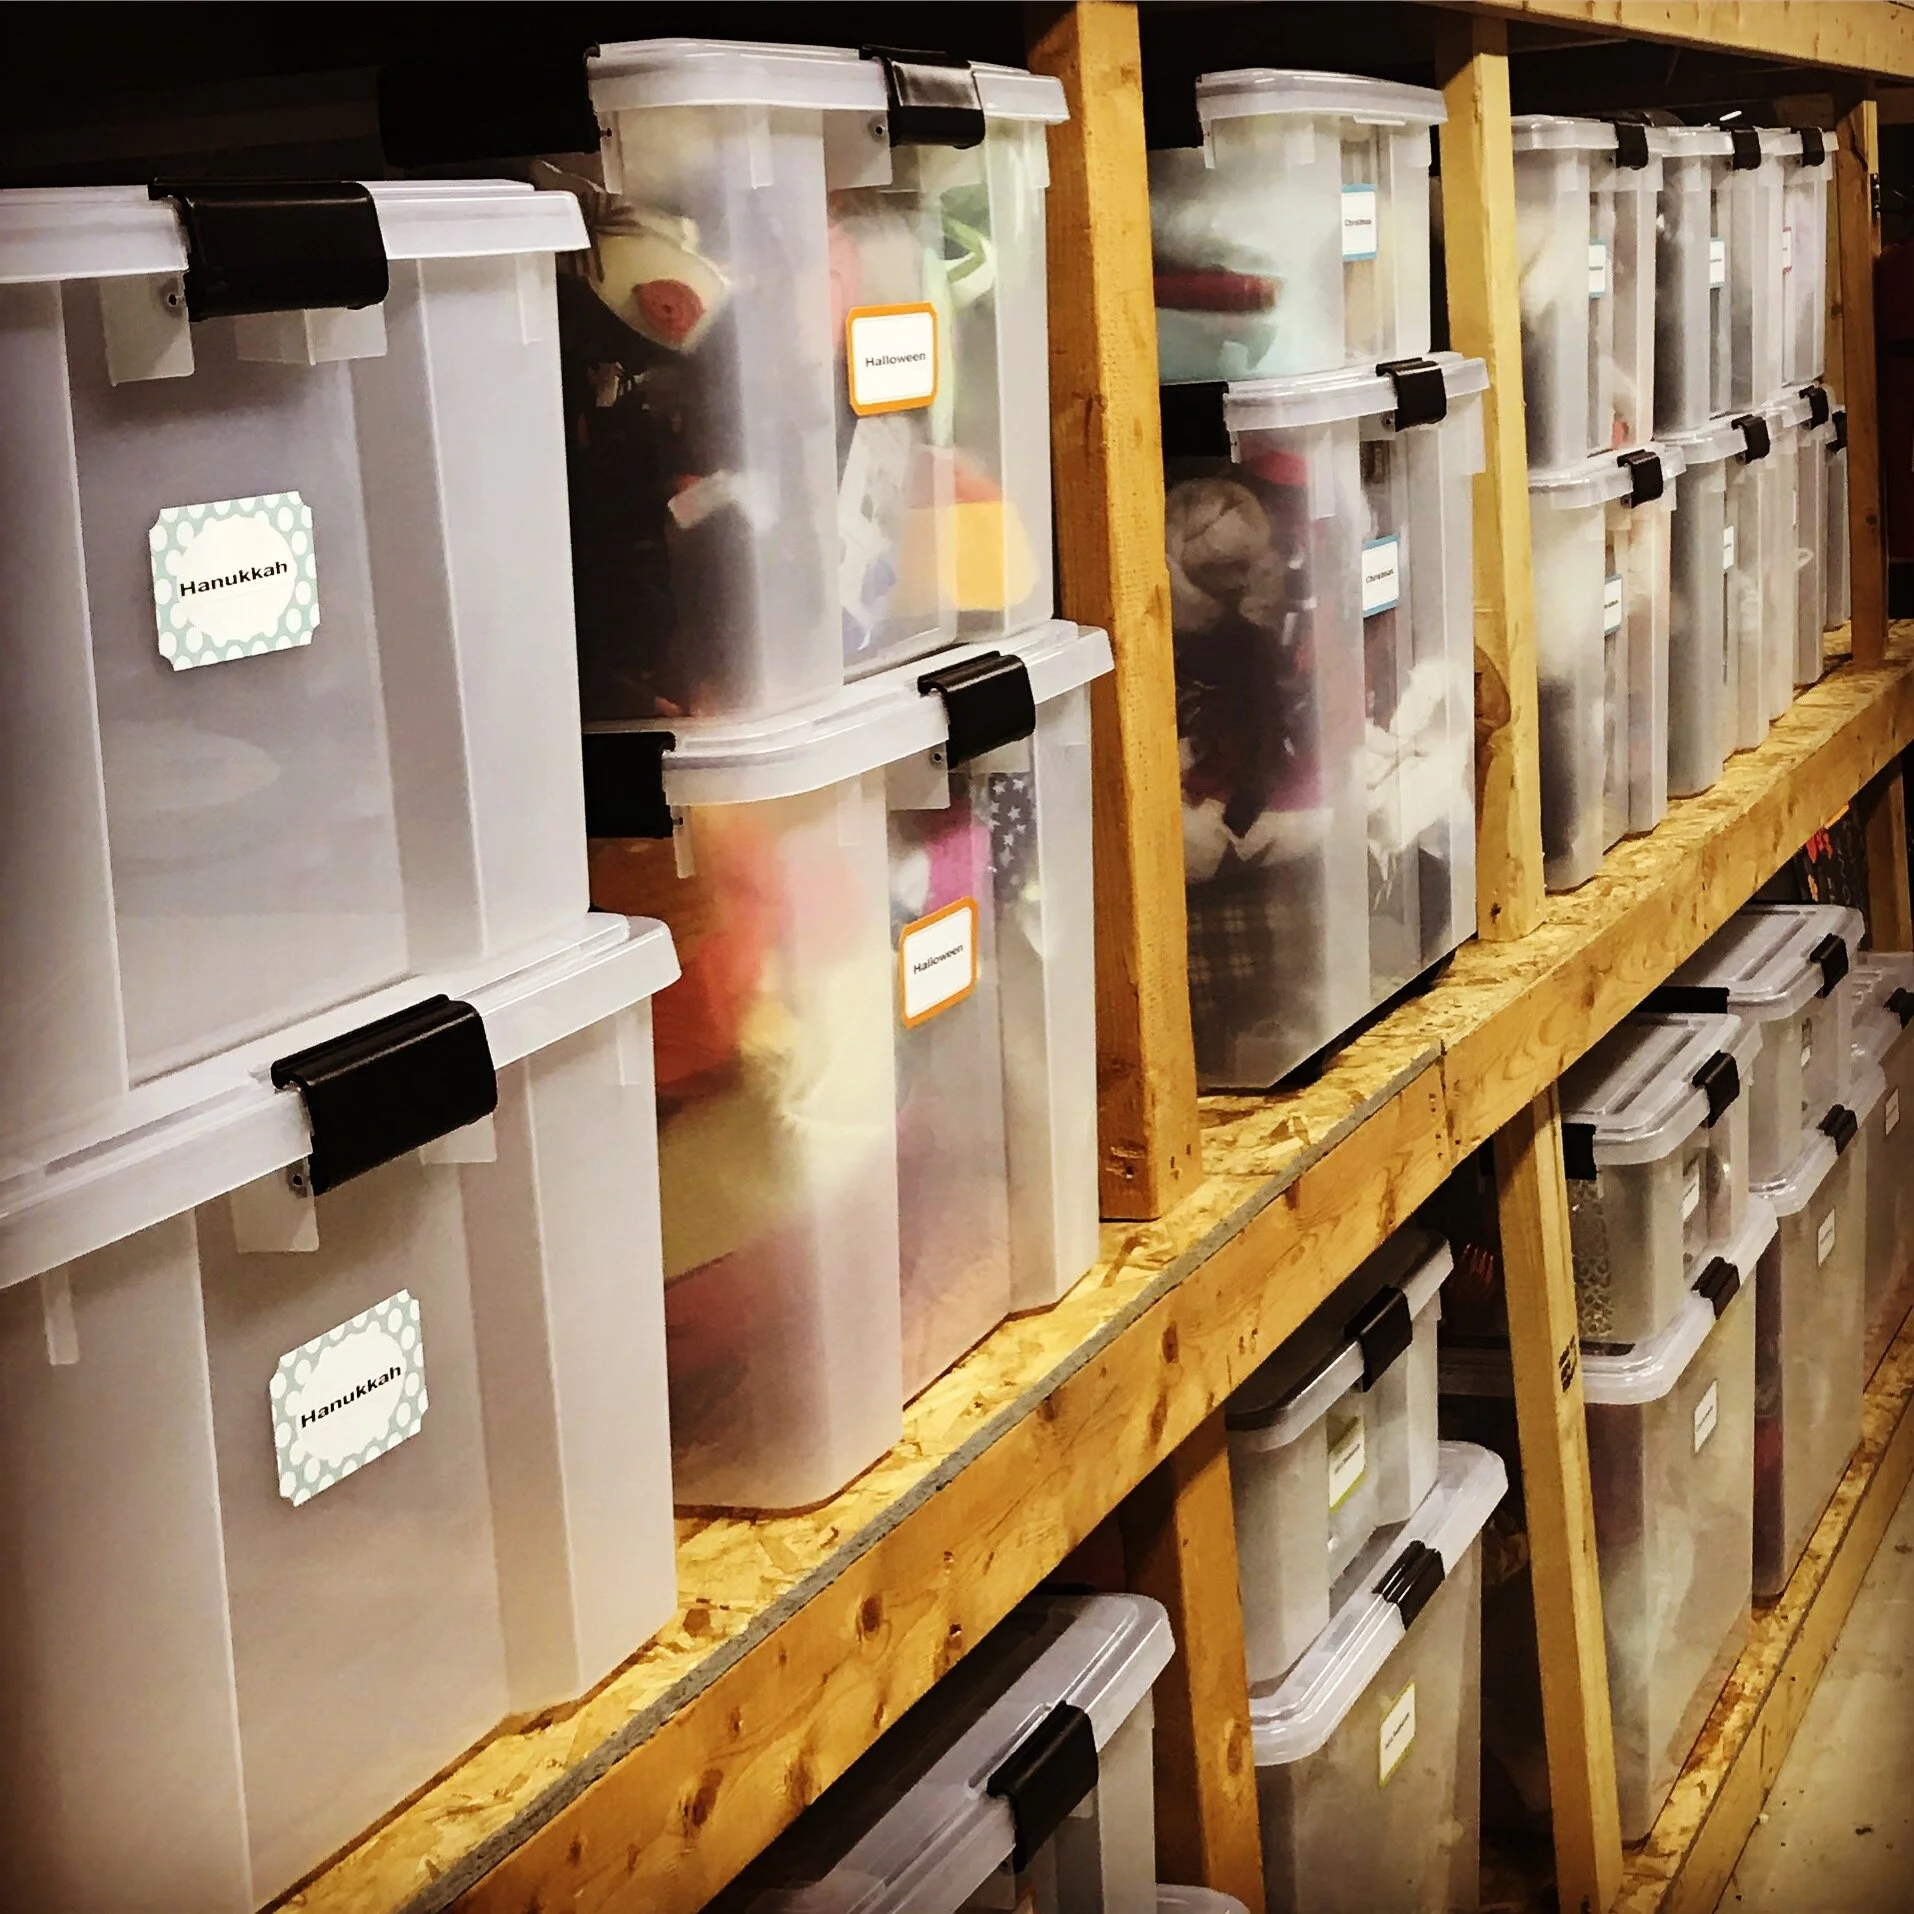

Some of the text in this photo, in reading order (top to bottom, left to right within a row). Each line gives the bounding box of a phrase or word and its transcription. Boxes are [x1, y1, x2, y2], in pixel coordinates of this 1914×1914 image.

[865, 353, 926, 367] Halloween
[180, 561, 288, 597] Hanukkah
[913, 944, 964, 975] Halloween
[300, 1366, 401, 1429] Hanukkah
